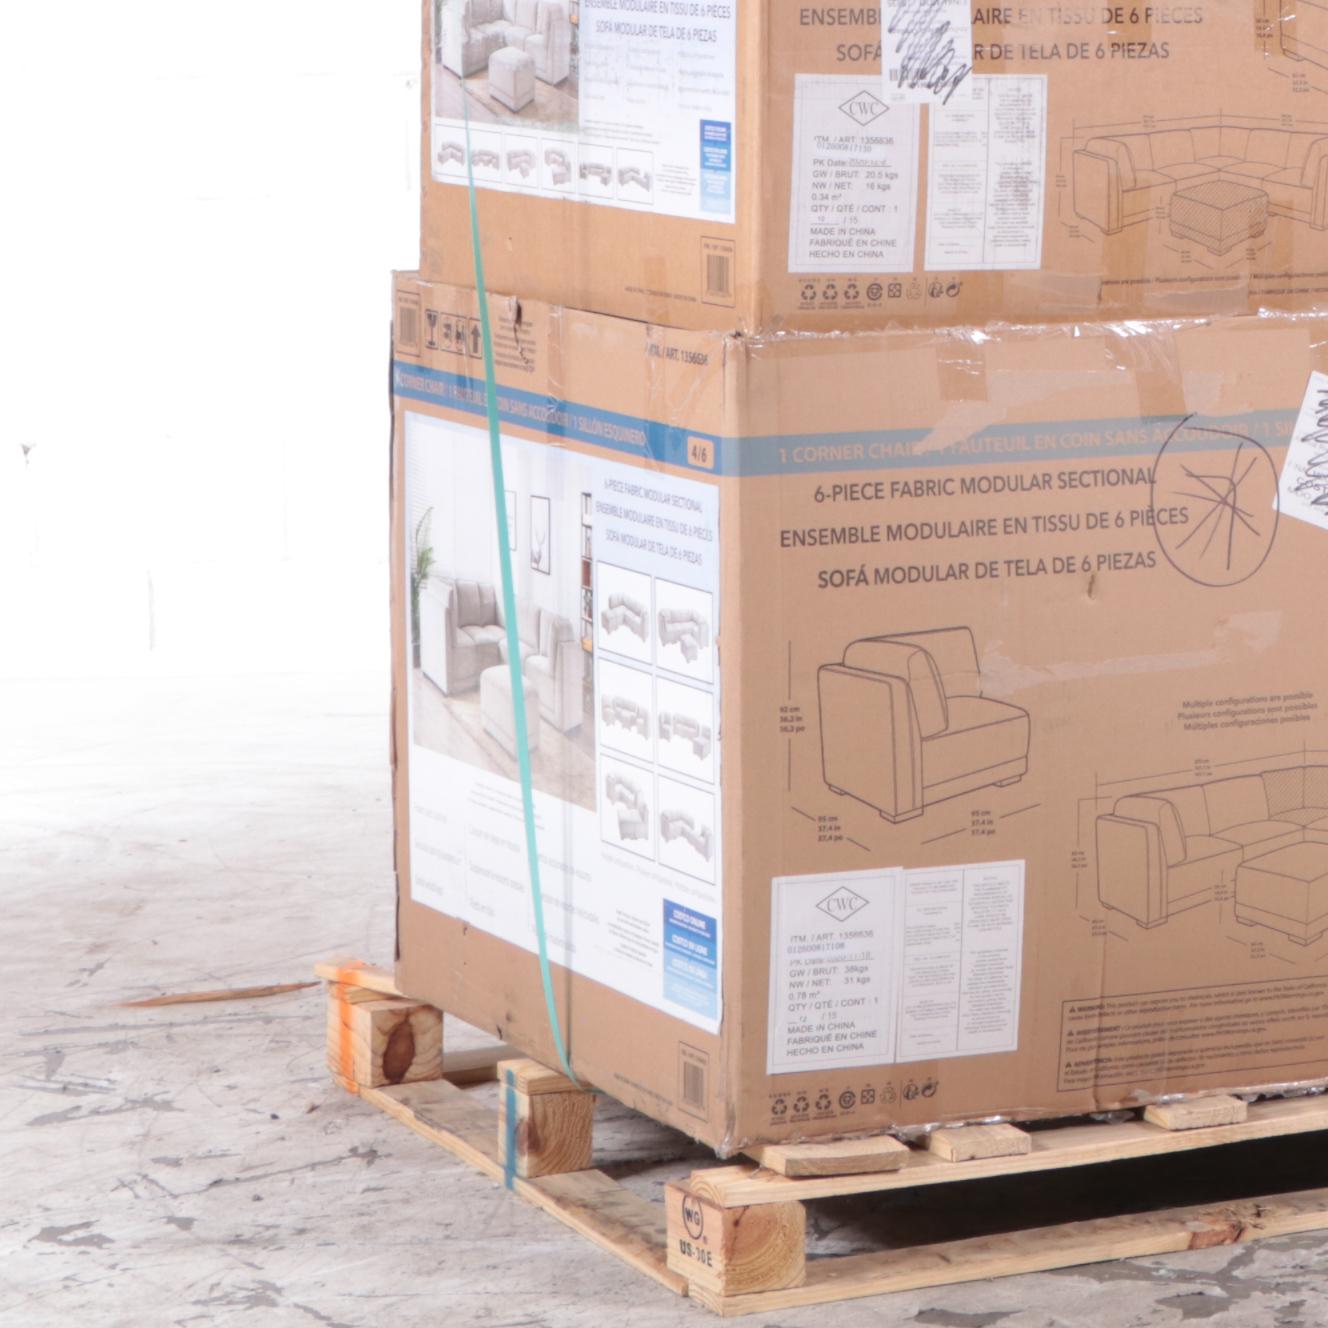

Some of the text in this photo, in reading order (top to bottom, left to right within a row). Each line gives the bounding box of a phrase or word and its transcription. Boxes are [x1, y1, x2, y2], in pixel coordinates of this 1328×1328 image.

[990, 43, 1013, 59] DE
[1066, 42, 1089, 59] DE
[1095, 43, 1105, 59] 6
[1110, 42, 1169, 58] PIEZAS
[810, 227, 834, 235] MADE
[692, 445, 706, 462] 4/6
[792, 444, 863, 462] CORNER
[814, 467, 1156, 502] 6-PIECE FABRIC MODULAR SECTIONAL
[780, 504, 1188, 547] ENSEMBLE MODULAIRE EN TISSU DE 6 PIÈCES
[818, 551, 1155, 588] SOFÁ MODULAR DE TELA DE 6 PIEZAS
